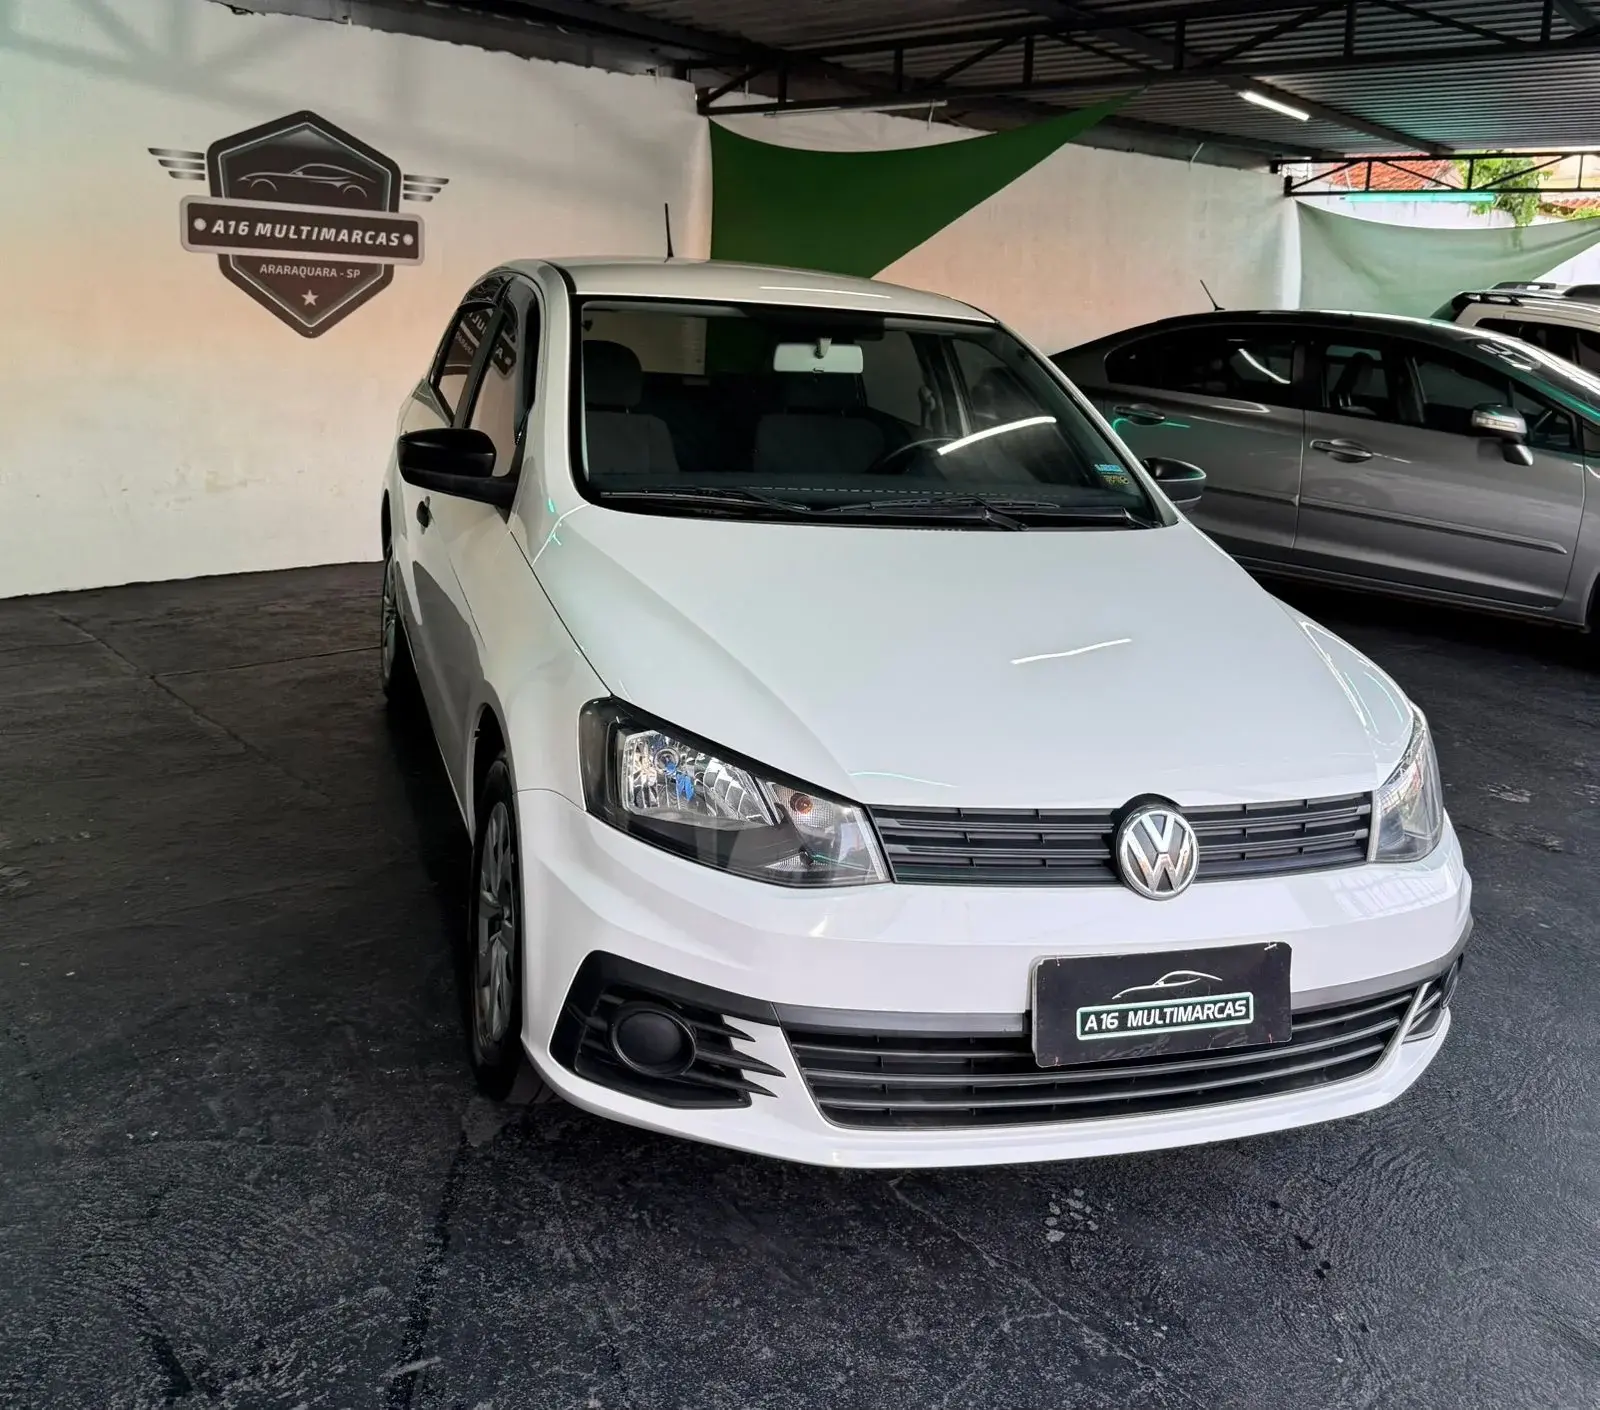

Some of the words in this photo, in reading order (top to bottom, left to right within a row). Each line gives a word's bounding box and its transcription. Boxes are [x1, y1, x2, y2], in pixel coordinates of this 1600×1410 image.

[212, 220, 249, 236] A16
[254, 223, 400, 246] MULTIMARCAS
[260, 263, 338, 278] ARARAQUARA
[346, 269, 361, 279] SP
[1127, 1000, 1247, 1027] MULTIMARCAS
